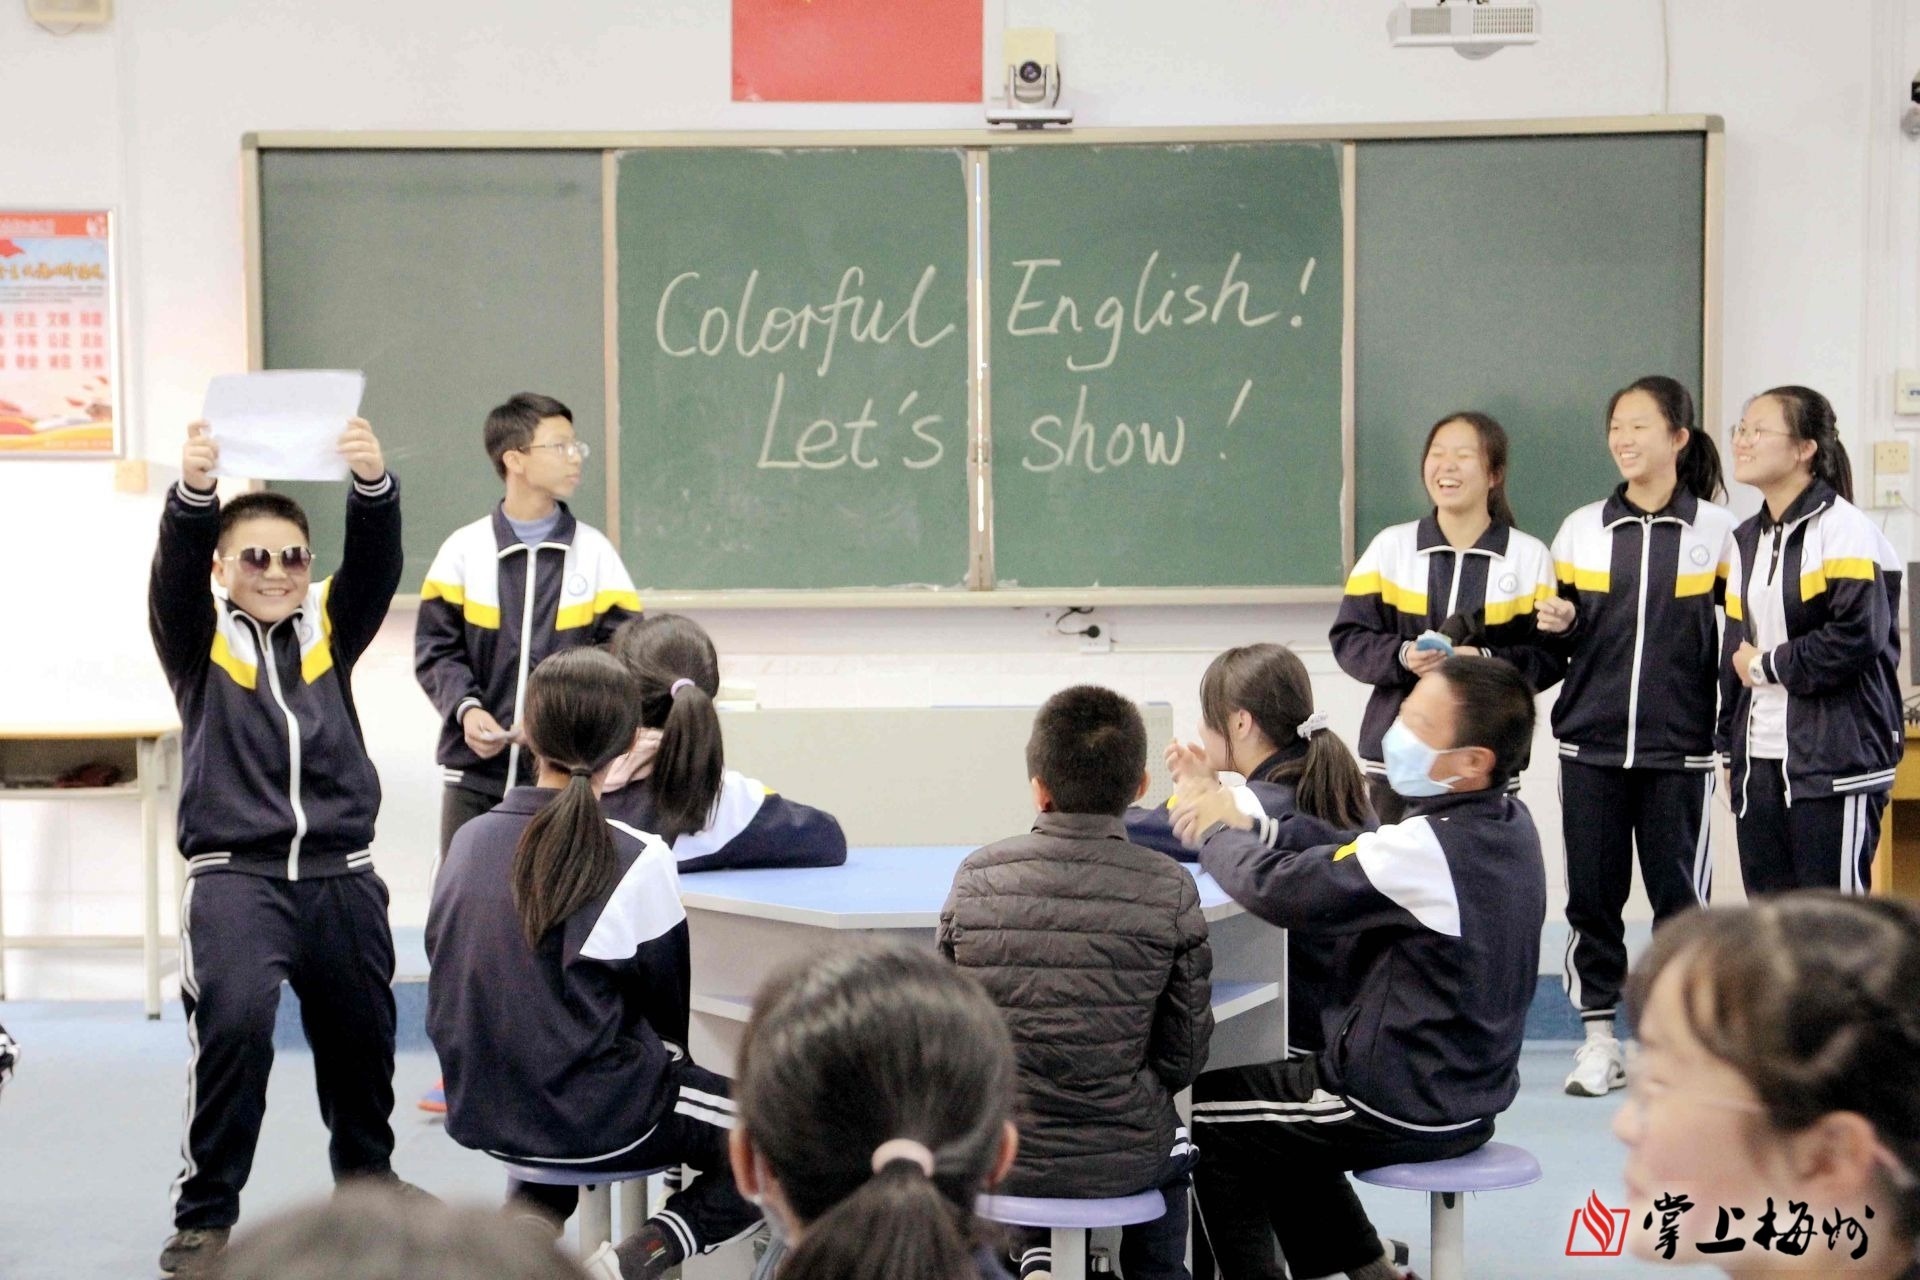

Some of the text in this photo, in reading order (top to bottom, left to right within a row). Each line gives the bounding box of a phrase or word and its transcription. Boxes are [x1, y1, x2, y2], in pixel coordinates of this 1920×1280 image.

[656, 250, 1317, 377] Colorful English!
[757, 369, 944, 469] Let's
